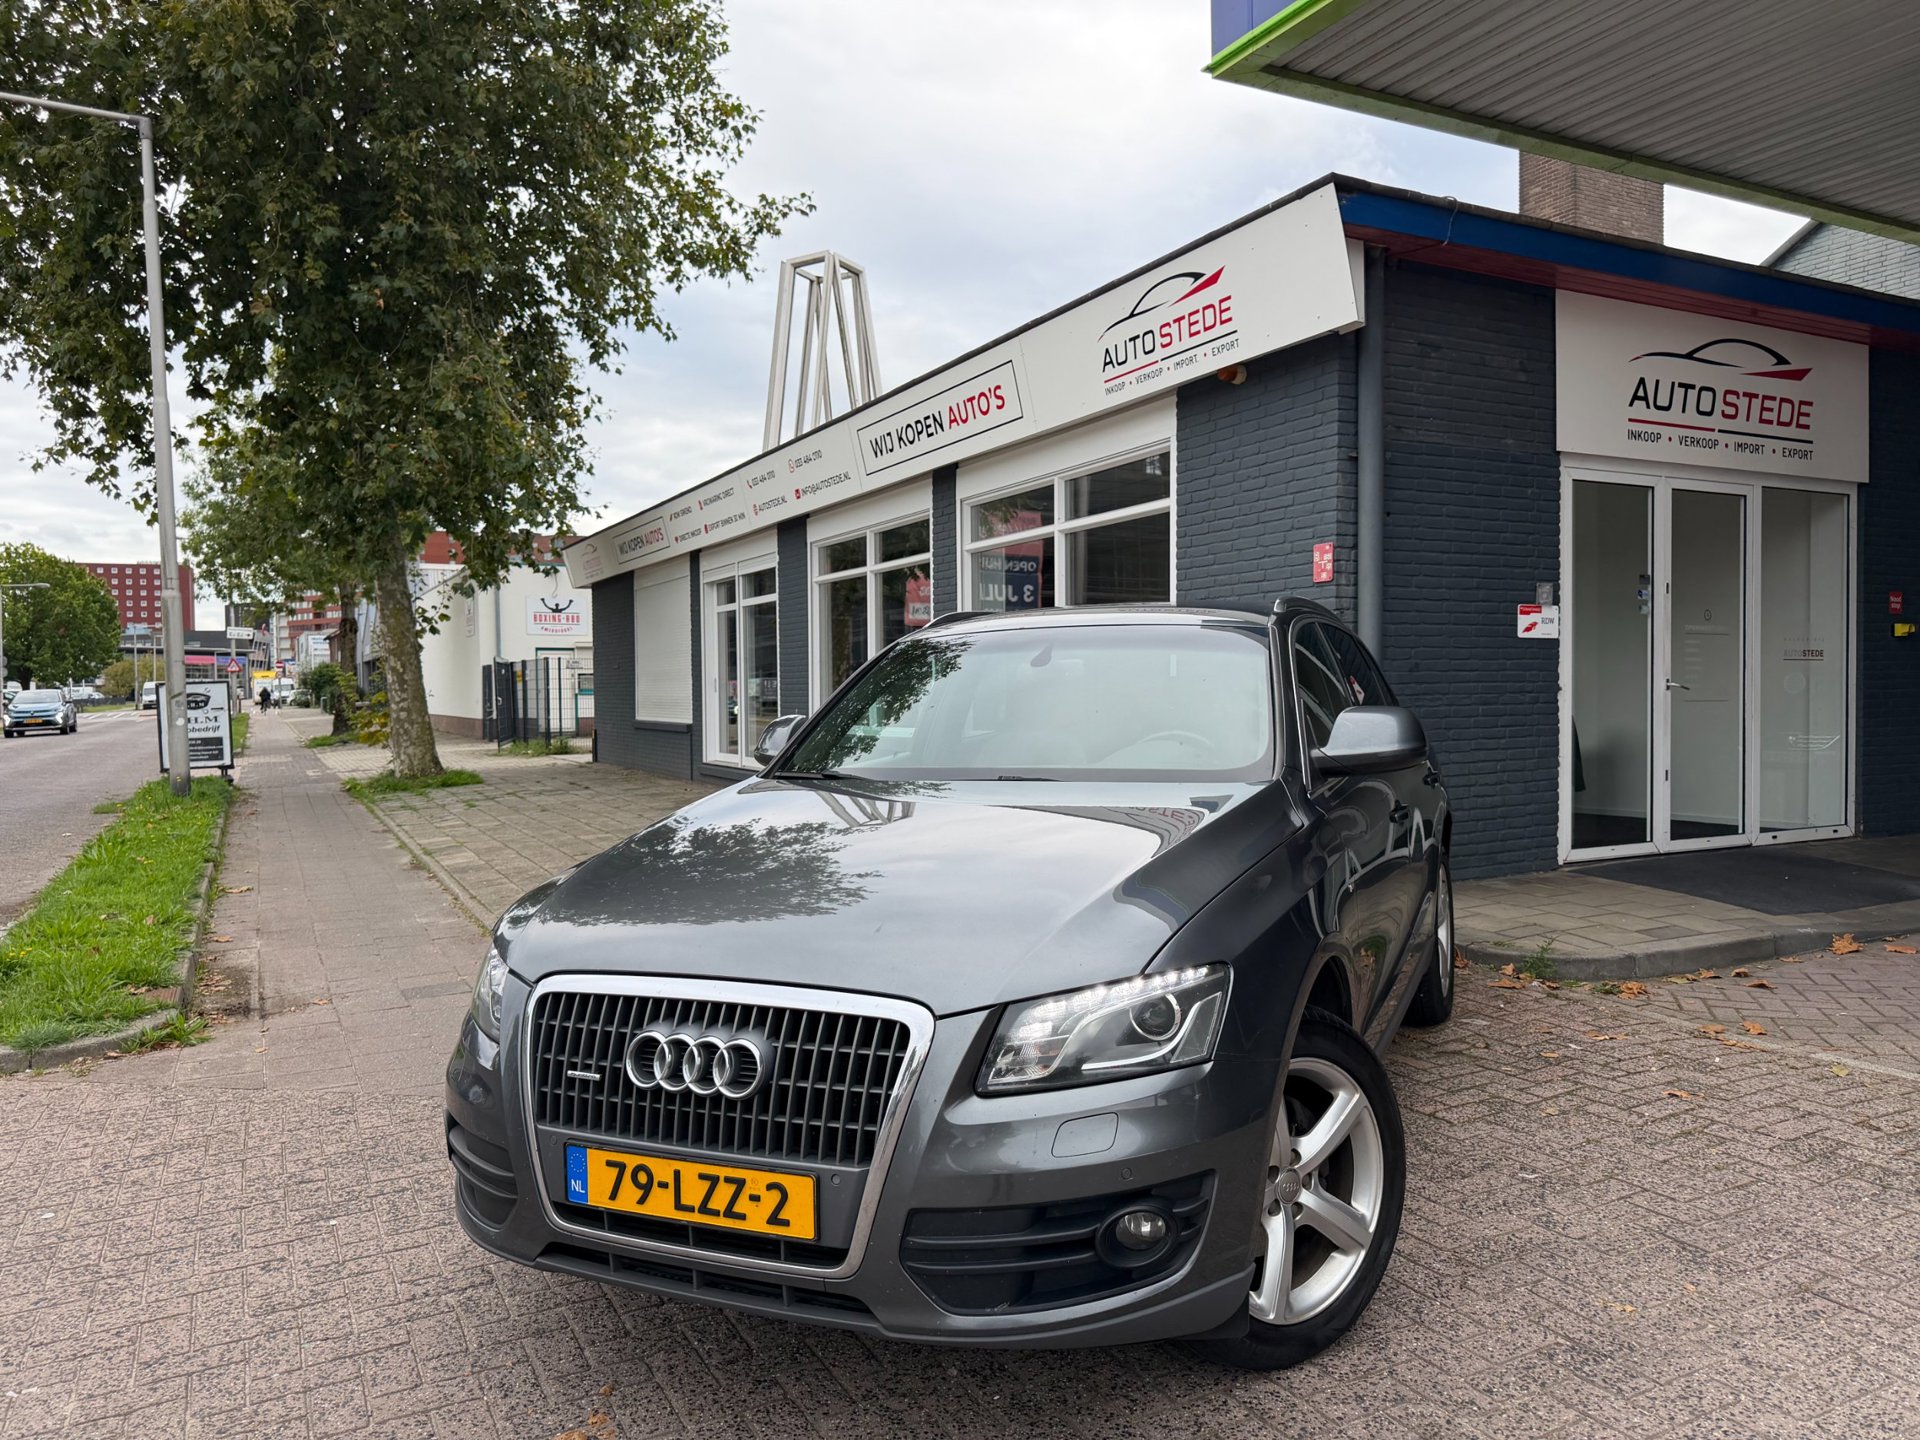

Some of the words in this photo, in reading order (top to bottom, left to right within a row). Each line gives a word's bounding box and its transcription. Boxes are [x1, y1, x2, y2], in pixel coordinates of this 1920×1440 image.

[1104, 381, 1126, 396] INKOOP
[1134, 367, 1164, 385] VERKOOP
[1173, 354, 1198, 371] IMPORT
[1211, 338, 1240, 357] EXPORT
[869, 430, 895, 459] WIJ
[896, 410, 945, 450] KOPEN
[948, 384, 1006, 430] AUTO'S
[1627, 428, 1662, 444] INKOOP
[1678, 434, 1719, 450] VERKOOP
[1733, 441, 1766, 456] IMPORT
[1782, 447, 1814, 461] EXPORT
[801, 470, 851, 497] INFO@AUTOSTEDE.NL
[571, 1178, 586, 1194] NL
[604, 1159, 791, 1228] 79-LZZ-2
